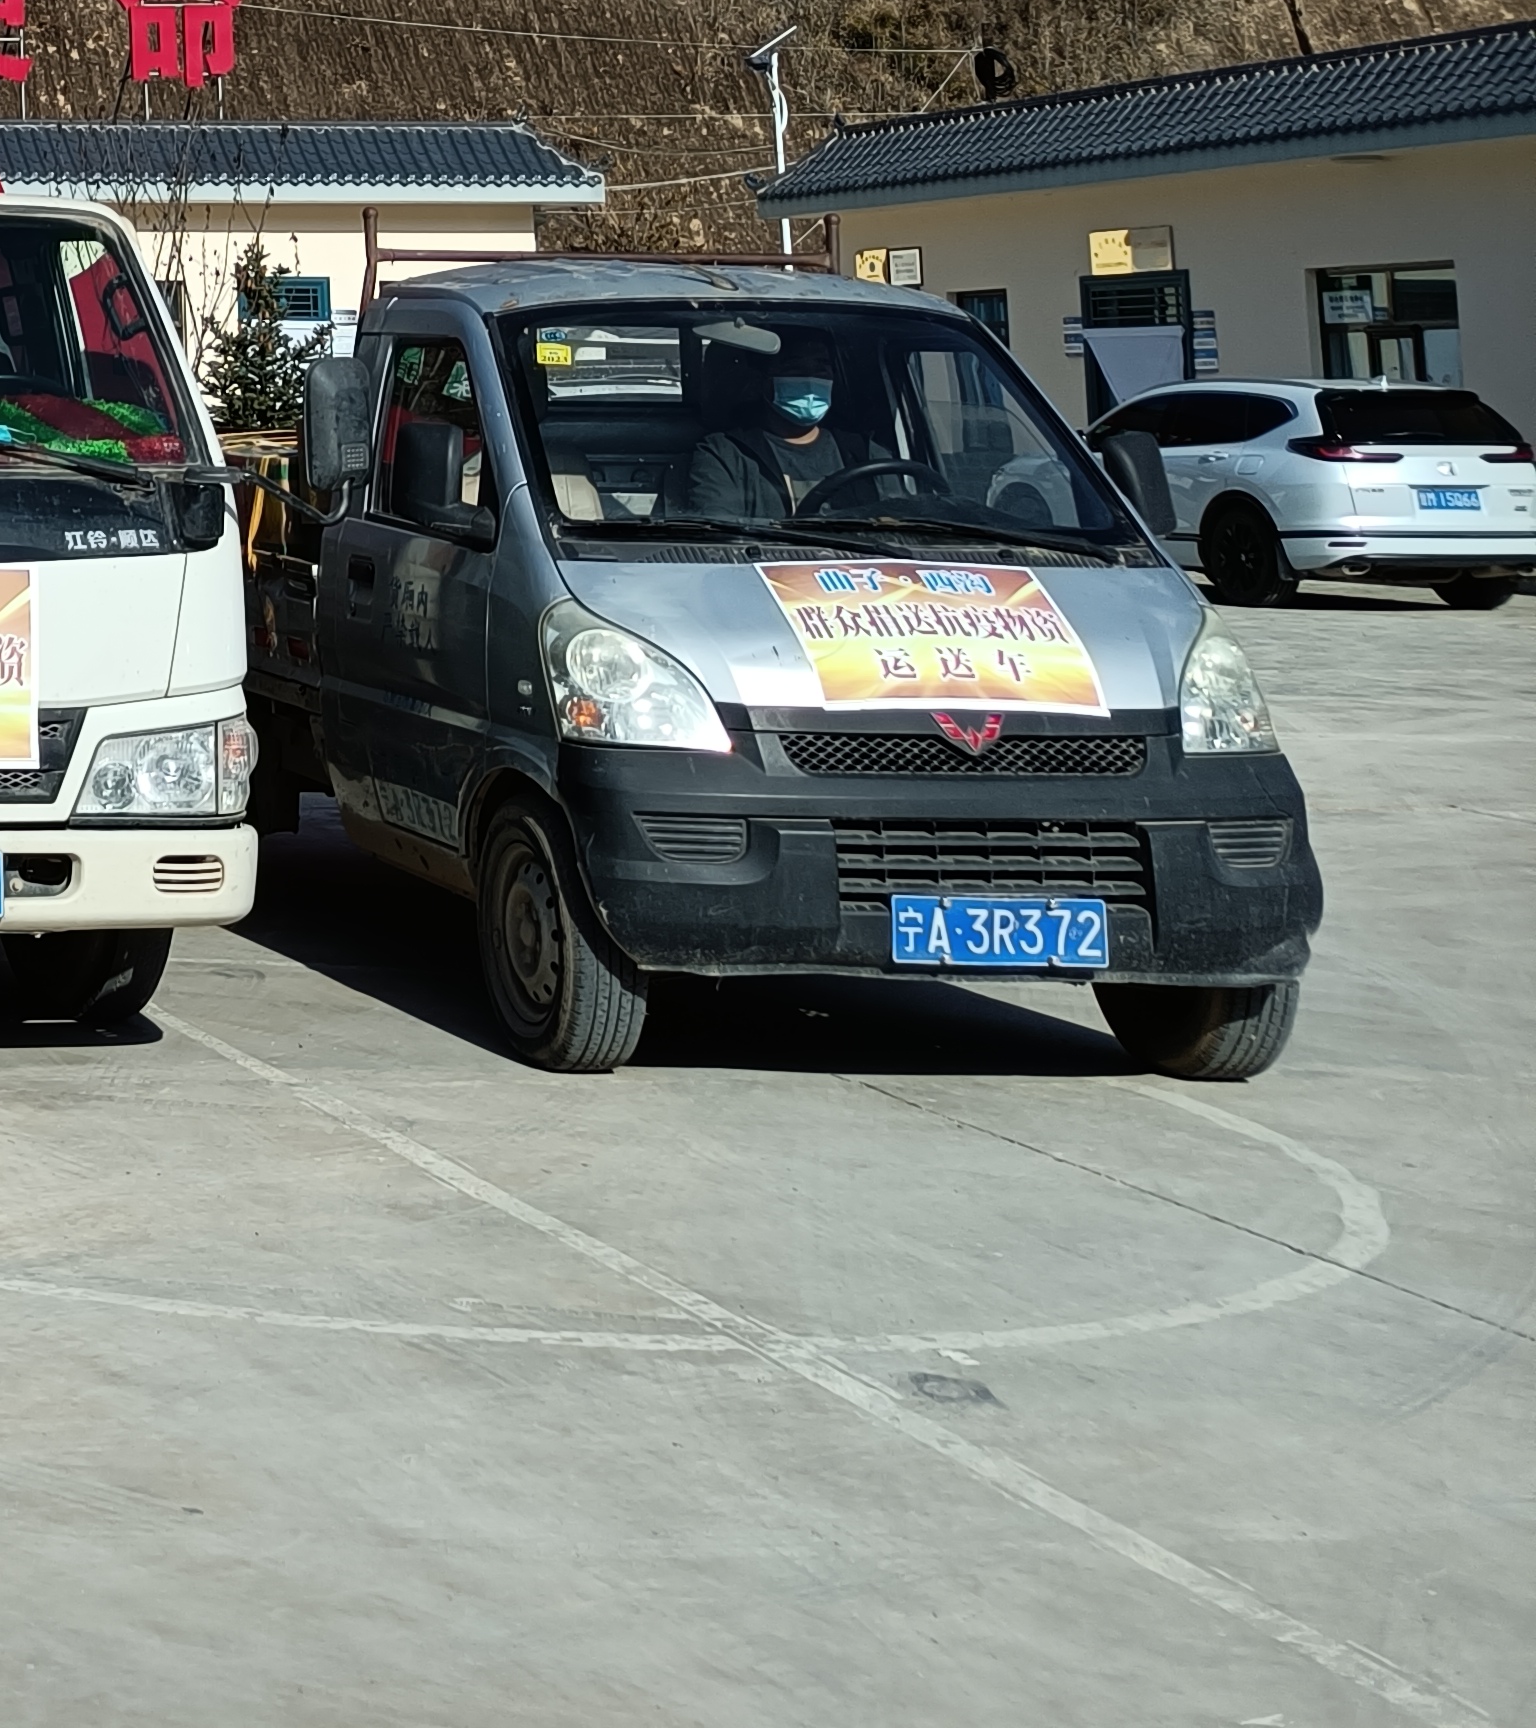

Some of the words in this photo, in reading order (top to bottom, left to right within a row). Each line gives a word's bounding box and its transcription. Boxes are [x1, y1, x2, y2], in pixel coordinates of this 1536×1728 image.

[795, 605, 1070, 644] 群众捐送抗疫物资
[874, 647, 1032, 682] 运送车
